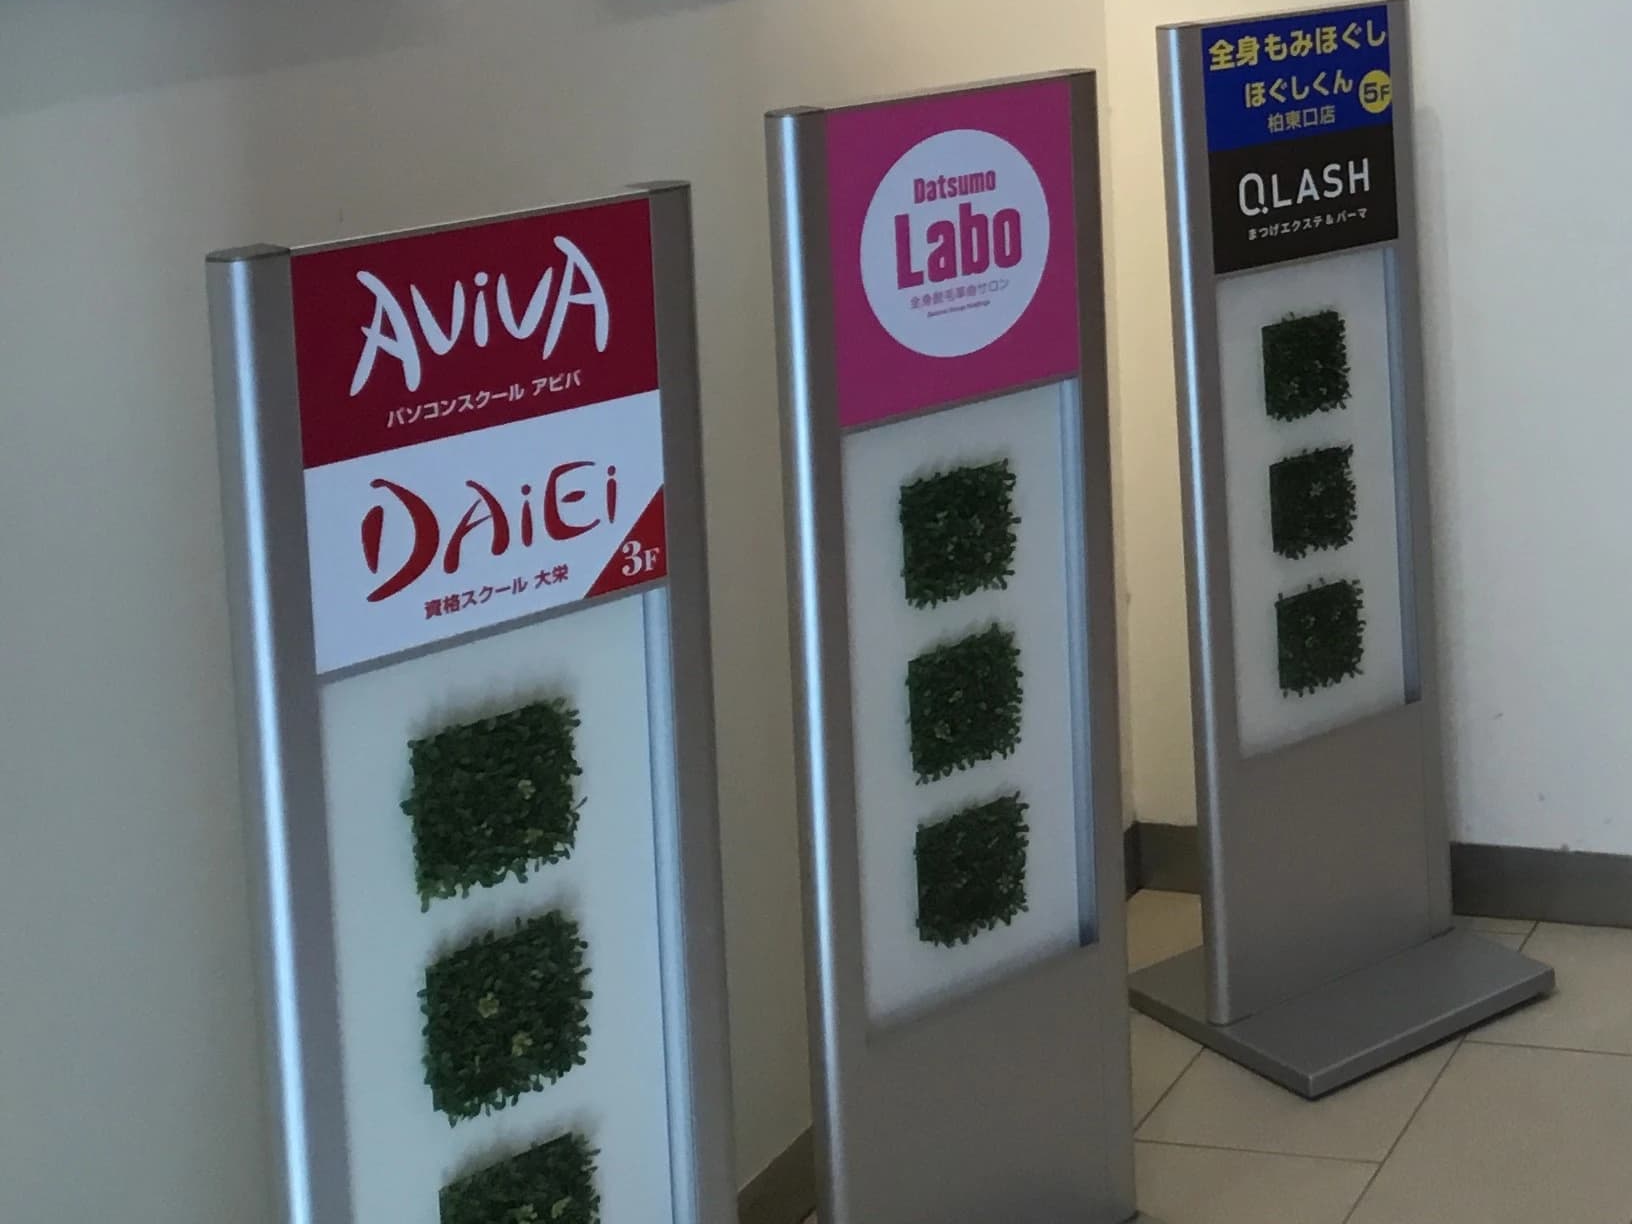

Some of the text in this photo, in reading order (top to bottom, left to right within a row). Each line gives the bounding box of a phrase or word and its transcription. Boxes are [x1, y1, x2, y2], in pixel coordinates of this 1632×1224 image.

[1208, 20, 1386, 71] 全身もみほぐし
[1244, 69, 1353, 108] ほぐしくん
[1363, 82, 1392, 104] 5F
[1267, 105, 1336, 133] 柏東口店
[914, 170, 997, 204] Datsumo
[1238, 157, 1370, 217] QLASH
[894, 201, 1022, 290] Labo
[387, 370, 582, 427] パソコンスクール アビバ
[622, 541, 660, 576] 3F
[424, 564, 569, 619] 資格スクール 大栄
